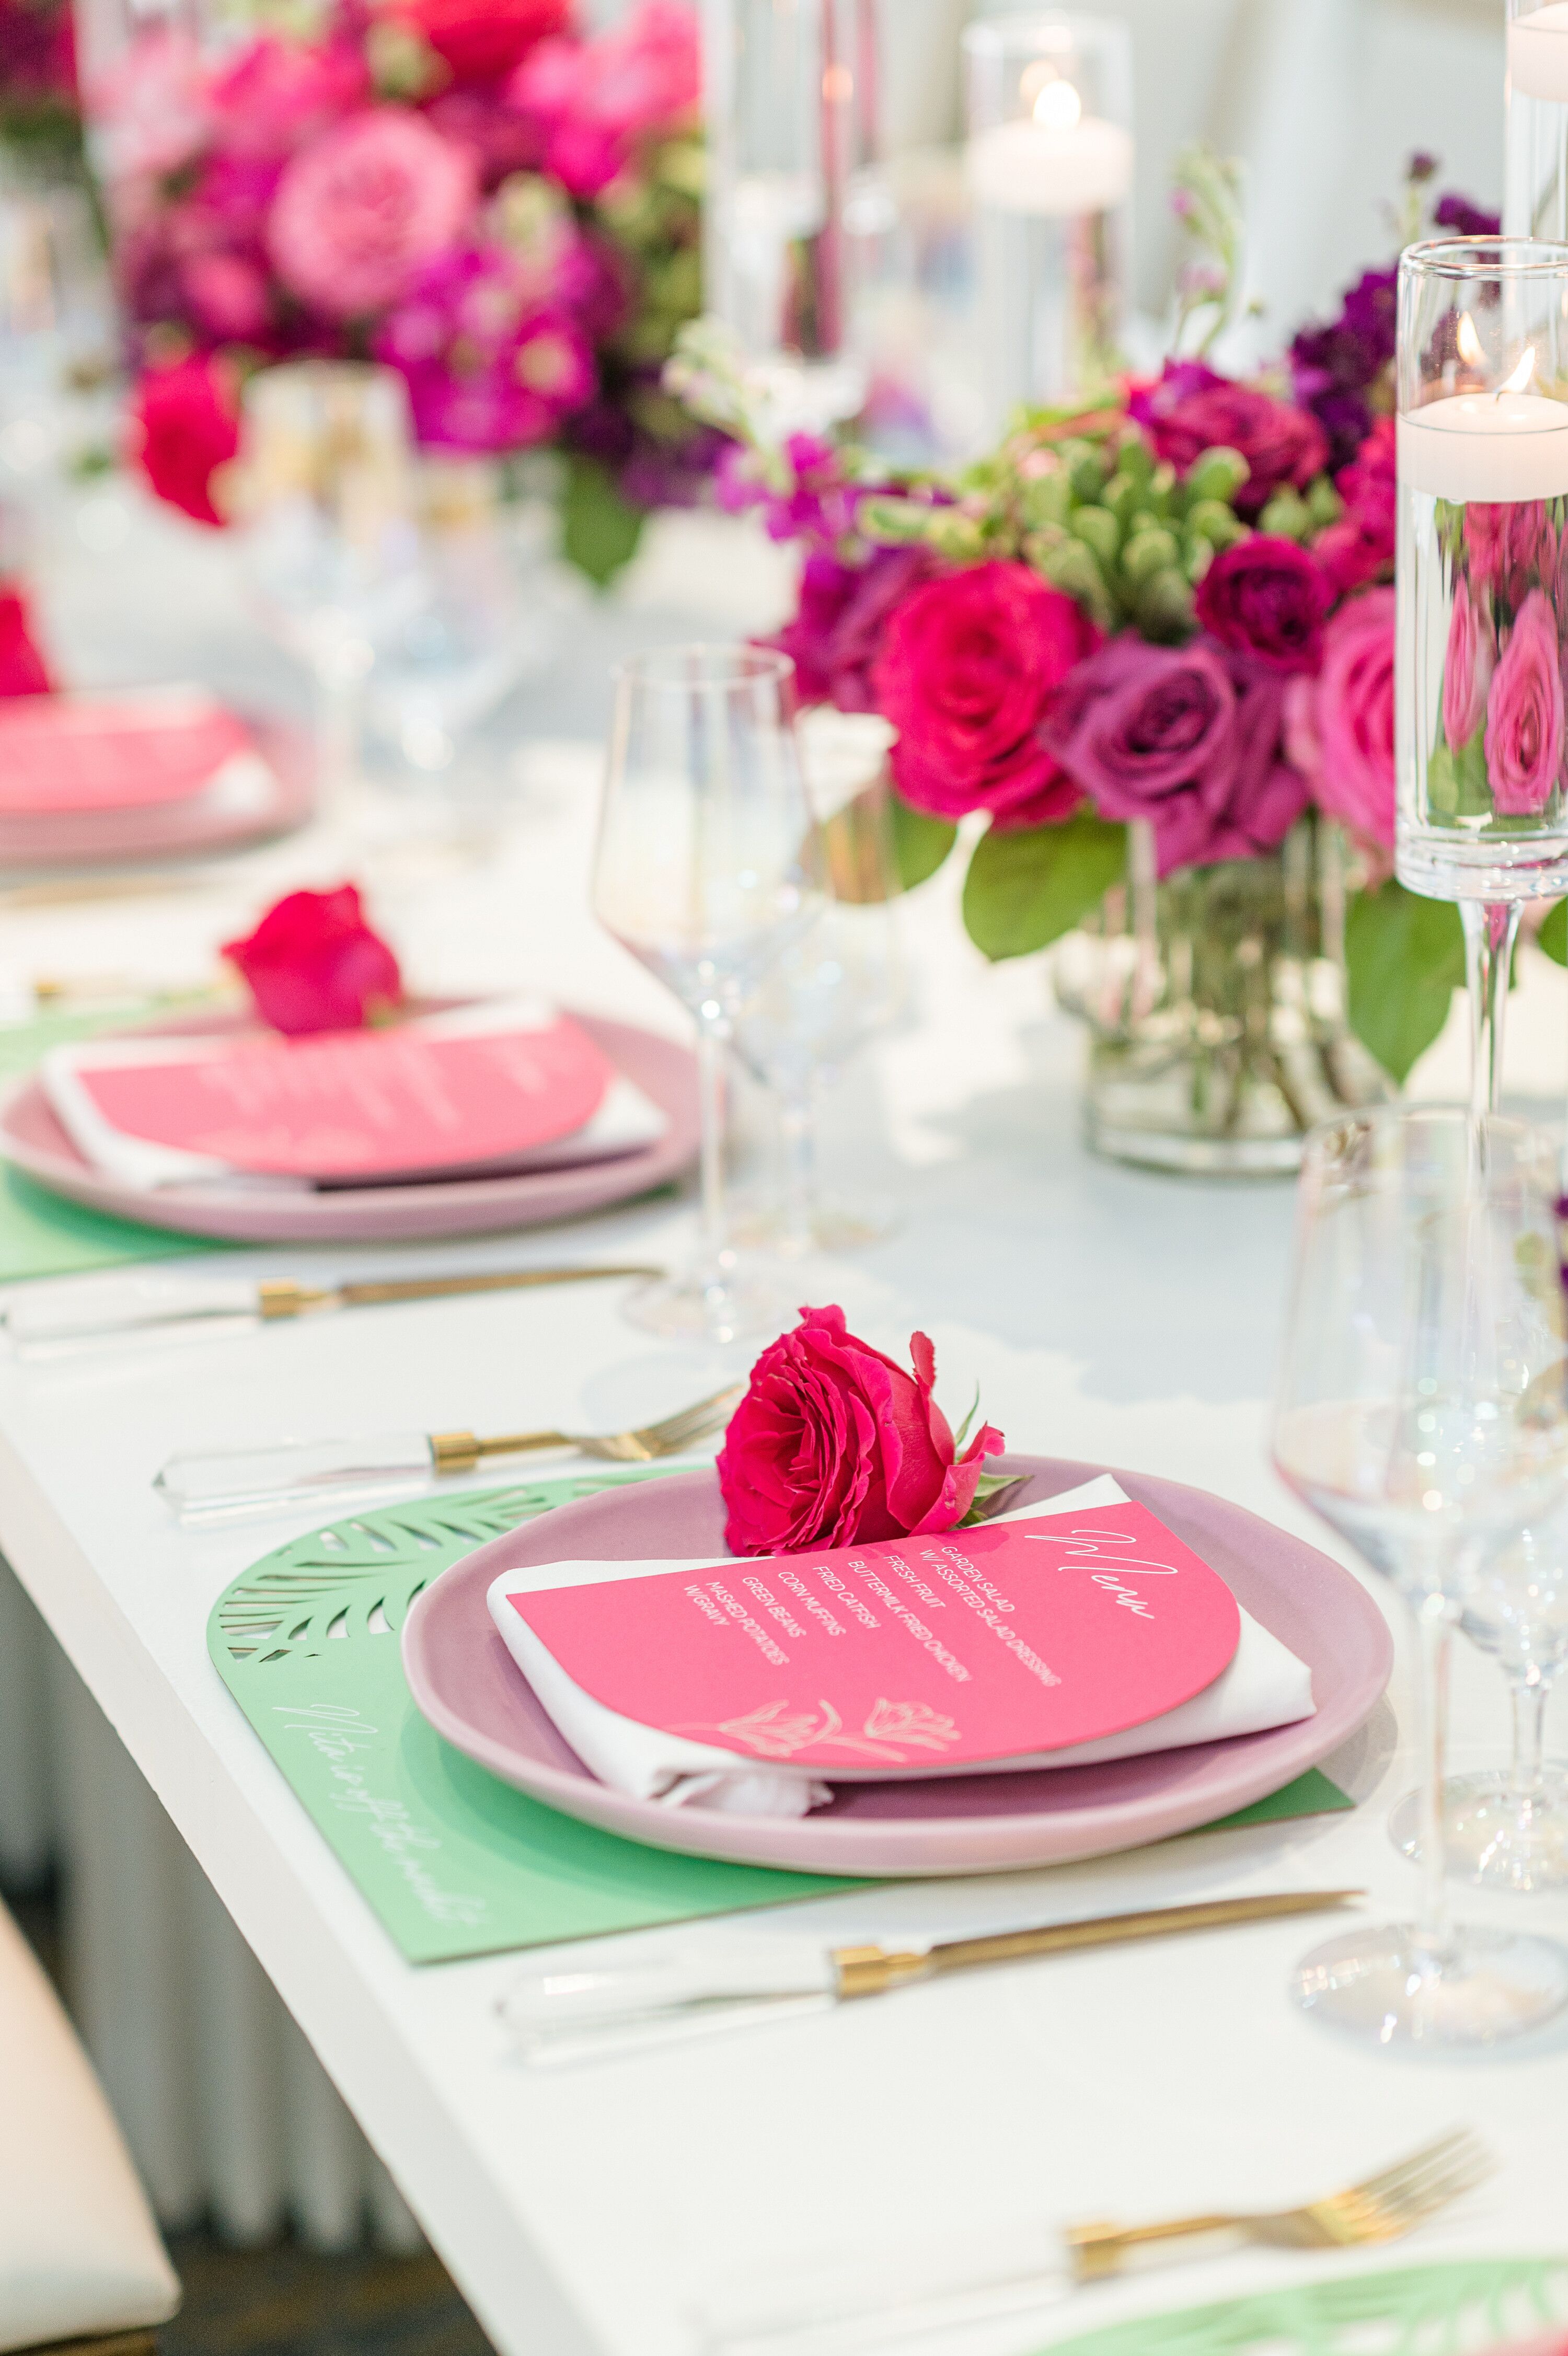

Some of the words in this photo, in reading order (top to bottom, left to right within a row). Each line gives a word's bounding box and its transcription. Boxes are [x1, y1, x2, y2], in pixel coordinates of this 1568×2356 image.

[883, 1555, 920, 1584] FRESH
[910, 1583, 947, 1608] FRUIT
[919, 1549, 944, 1561] W/
[941, 1546, 987, 1582] GARDEN
[976, 1583, 1015, 1612] SALAD
[1024, 1530, 1179, 1620] Menu
[742, 1577, 779, 1607] GREEN
[768, 1606, 807, 1638] BEANS
[778, 1572, 811, 1597] CORN
[800, 1597, 847, 1636] MUFFINS
[813, 1566, 846, 1591] FRIED
[837, 1592, 882, 1629] CATFISH
[931, 1564, 985, 1609] ASSORTED
[706, 1581, 748, 1619] MASHED
[737, 1618, 790, 1666] POTATOES
[848, 1561, 909, 1614] BUTTERMILK
[897, 1613, 933, 1641] FRIED
[924, 1639, 973, 1683] CHICKEN
[976, 1609, 1016, 1640] SALAD
[1005, 1638, 1062, 1687] DRESSING
[271, 1704, 378, 1762] Nita
